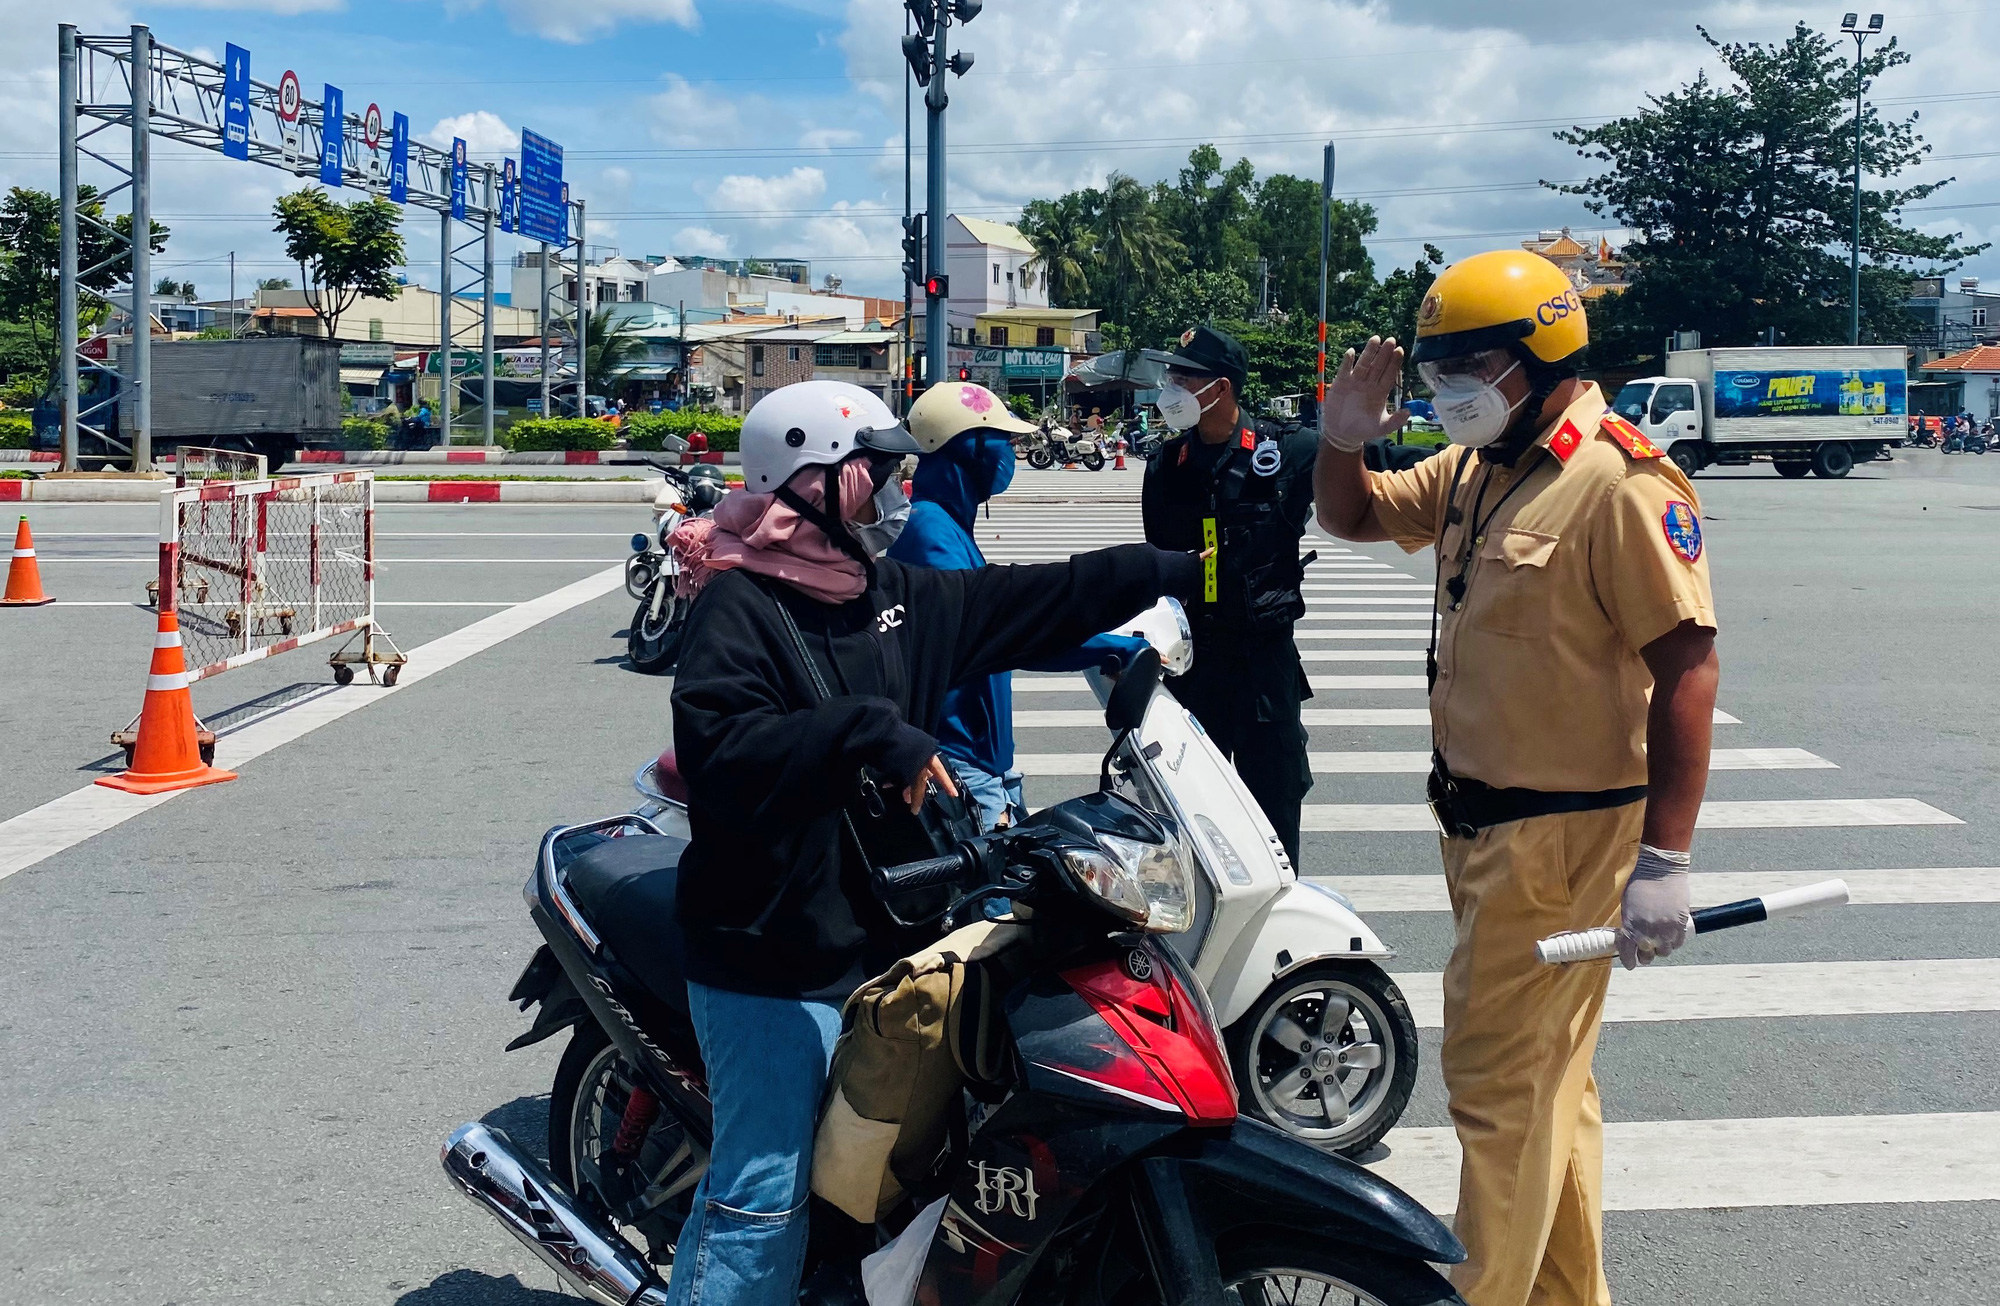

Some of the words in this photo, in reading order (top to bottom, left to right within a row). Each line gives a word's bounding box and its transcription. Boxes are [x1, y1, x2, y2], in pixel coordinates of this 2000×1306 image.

[284, 84, 294, 106] 80
[370, 117, 378, 136] 60
[1536, 289, 1579, 326] CSG
[1767, 375, 1816, 399] POWER
